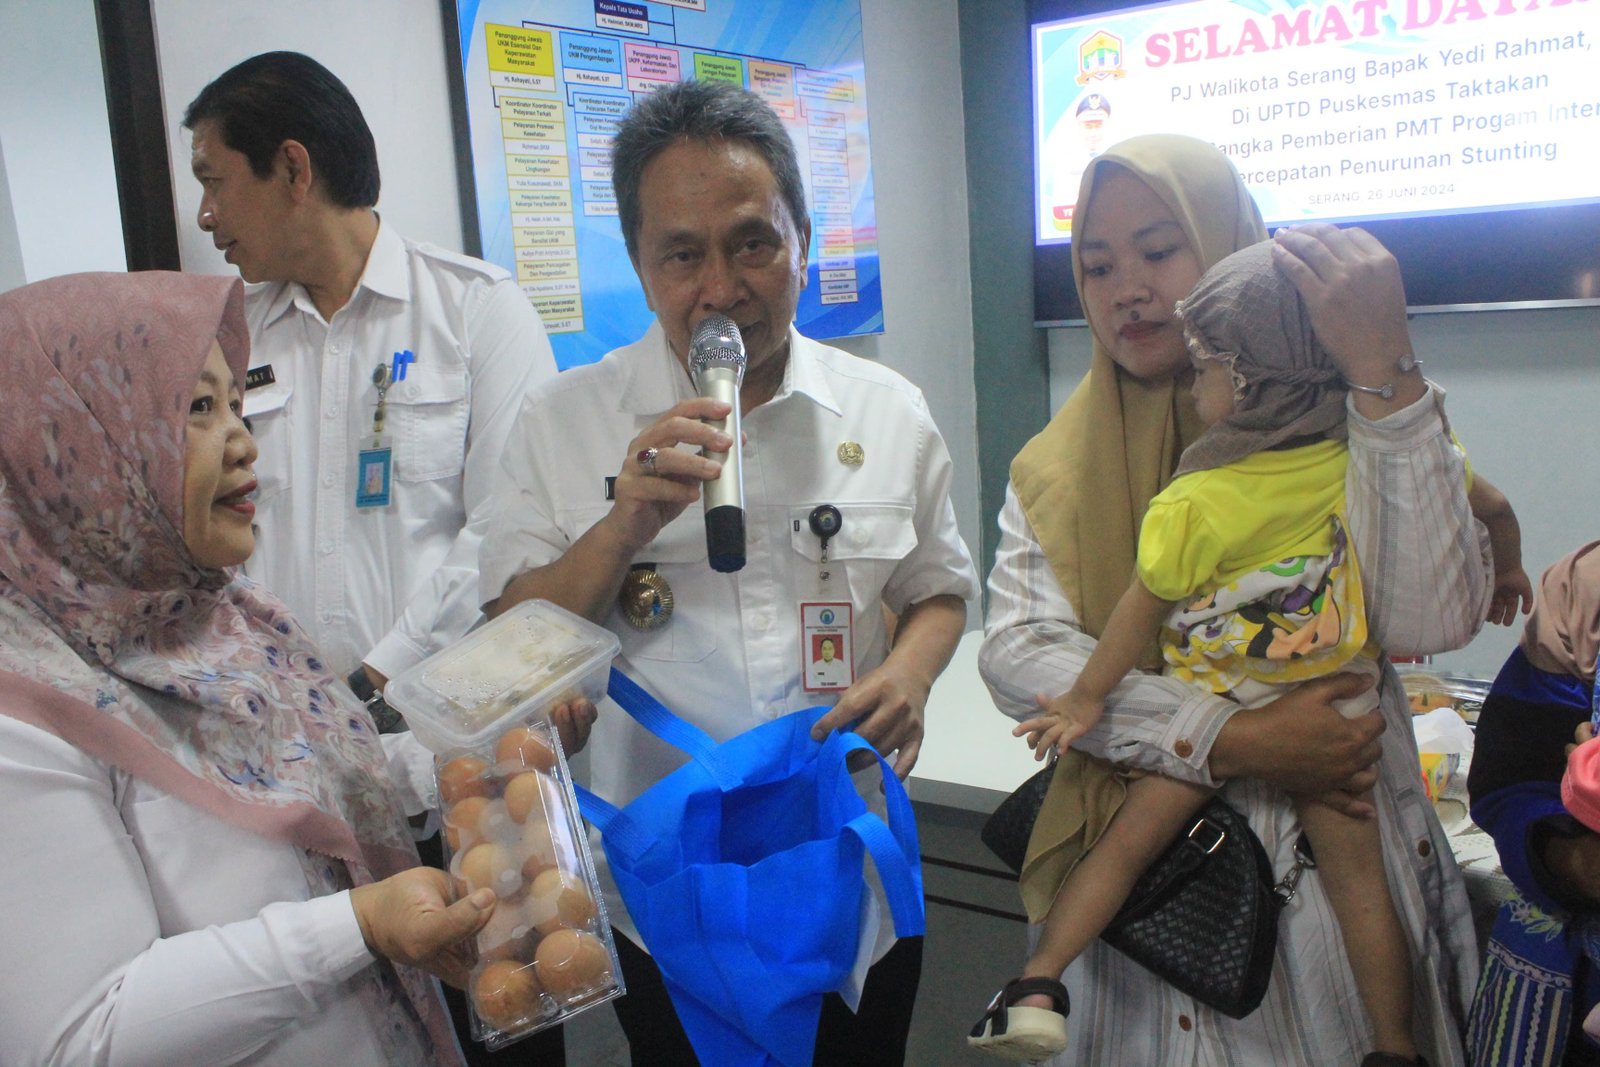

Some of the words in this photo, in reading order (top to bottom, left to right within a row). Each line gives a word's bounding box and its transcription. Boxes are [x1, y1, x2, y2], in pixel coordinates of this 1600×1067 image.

[617, 5, 629, 14] Tata
[1145, 0, 1388, 67] SELAMAT
[1170, 85, 1192, 102] PJ
[1200, 77, 1279, 98] Walikota
[1287, 66, 1357, 87] Serang
[1365, 54, 1429, 79] Bapak
[1439, 44, 1485, 67] Yedi
[1495, 31, 1592, 60] Rahmat,
[1232, 107, 1249, 125] Di
[1258, 101, 1311, 122] UPTD
[1320, 88, 1436, 115] Puskesmas
[1446, 74, 1549, 100] Taktakan
[1211, 138, 1274, 158] angka
[1282, 126, 1387, 150] Pemberian
[1396, 117, 1443, 139] PMT
[1453, 109, 1538, 133] Progam
[1239, 164, 1331, 185] ercepatan
[1340, 153, 1451, 176] Penurunan
[1462, 140, 1557, 165] Stunting
[1368, 189, 1384, 200] 26
[1387, 186, 1417, 199] JUNI
[1421, 183, 1456, 196] 2024
